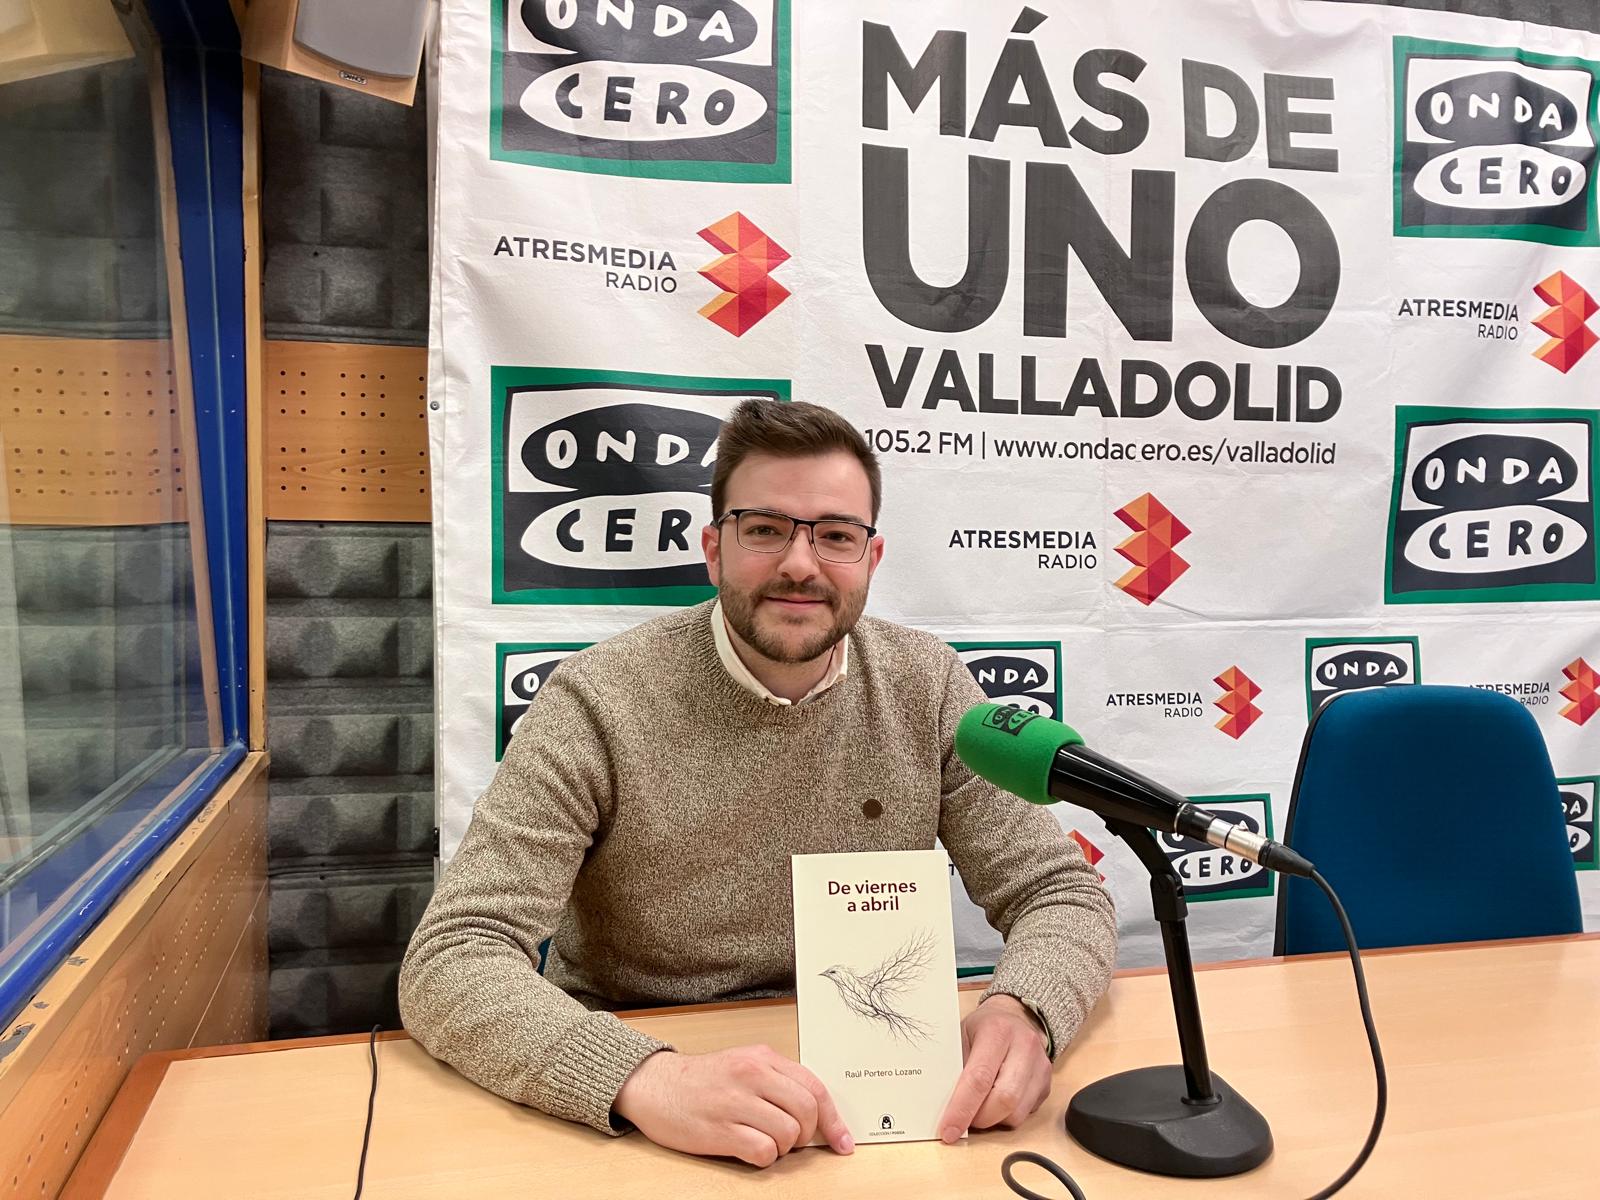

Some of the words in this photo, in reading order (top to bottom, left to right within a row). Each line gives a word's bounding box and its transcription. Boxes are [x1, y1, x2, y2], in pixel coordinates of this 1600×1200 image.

[545, 0, 735, 43] ONDA
[555, 73, 735, 126] CERO
[862, 6, 1150, 155] MÁS
[1182, 58, 1339, 173] DE
[1430, 92, 1563, 131] ONDA
[1440, 157, 1572, 197] CERO
[493, 236, 678, 271] ATRESMEDIA
[862, 143, 1341, 349] UNO
[605, 271, 678, 294] RADIO
[1398, 298, 1519, 322] ATRESMEDIA
[1478, 323, 1518, 341] RADIO
[864, 344, 1342, 423] VALLADOLID
[865, 429, 931, 454] 105.2
[939, 431, 973, 455] FM
[994, 437, 1337, 465] www.ondacero.es/valladolid
[1425, 457, 1563, 490] ONDA
[556, 508, 692, 553] CER
[949, 529, 1097, 549] ATRESMEDIA
[1429, 520, 1564, 560] CERO
[1038, 554, 1097, 569] RADIO
[978, 667, 1039, 684] NDA
[1324, 660, 1400, 680] ONDA
[1106, 692, 1202, 706] ATRESMEDIA
[1520, 695, 1549, 706] RADIO
[1164, 707, 1203, 718] RADIO
[1178, 855, 1253, 879] CERO
[828, 881, 851, 895] De
[855, 879, 917, 894] viernes
[847, 902, 857, 912] a
[861, 895, 900, 912] abril
[845, 1069, 862, 1079] Raúl
[864, 1069, 893, 1078] Portero
[895, 1068, 922, 1076] Lozano
